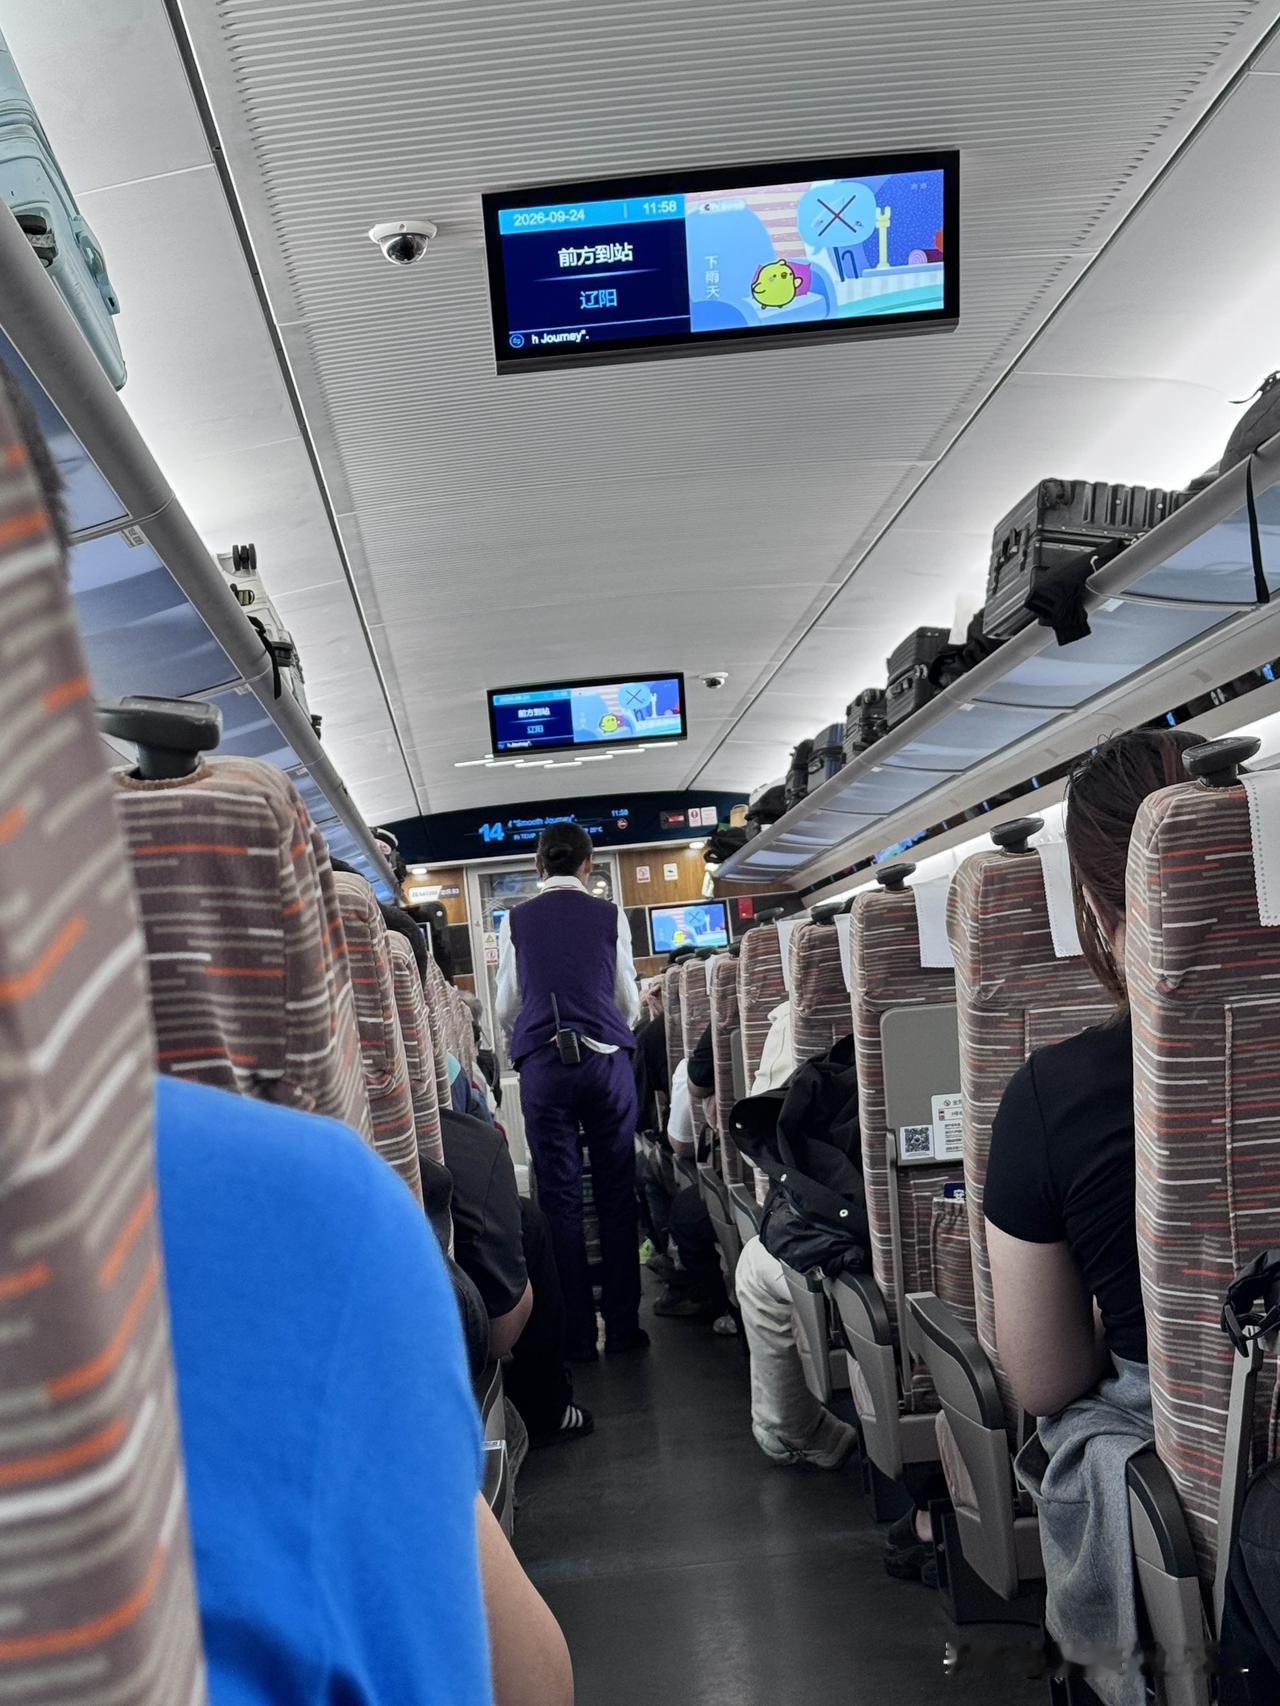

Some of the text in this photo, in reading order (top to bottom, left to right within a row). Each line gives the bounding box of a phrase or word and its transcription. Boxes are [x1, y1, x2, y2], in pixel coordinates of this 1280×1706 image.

[513, 200, 677, 227] 2026-09-24 11:58
[558, 242, 633, 267] 前方到站
[705, 255, 721, 299] 下雨天
[579, 288, 618, 310] 辽阳
[478, 821, 505, 843] 14
